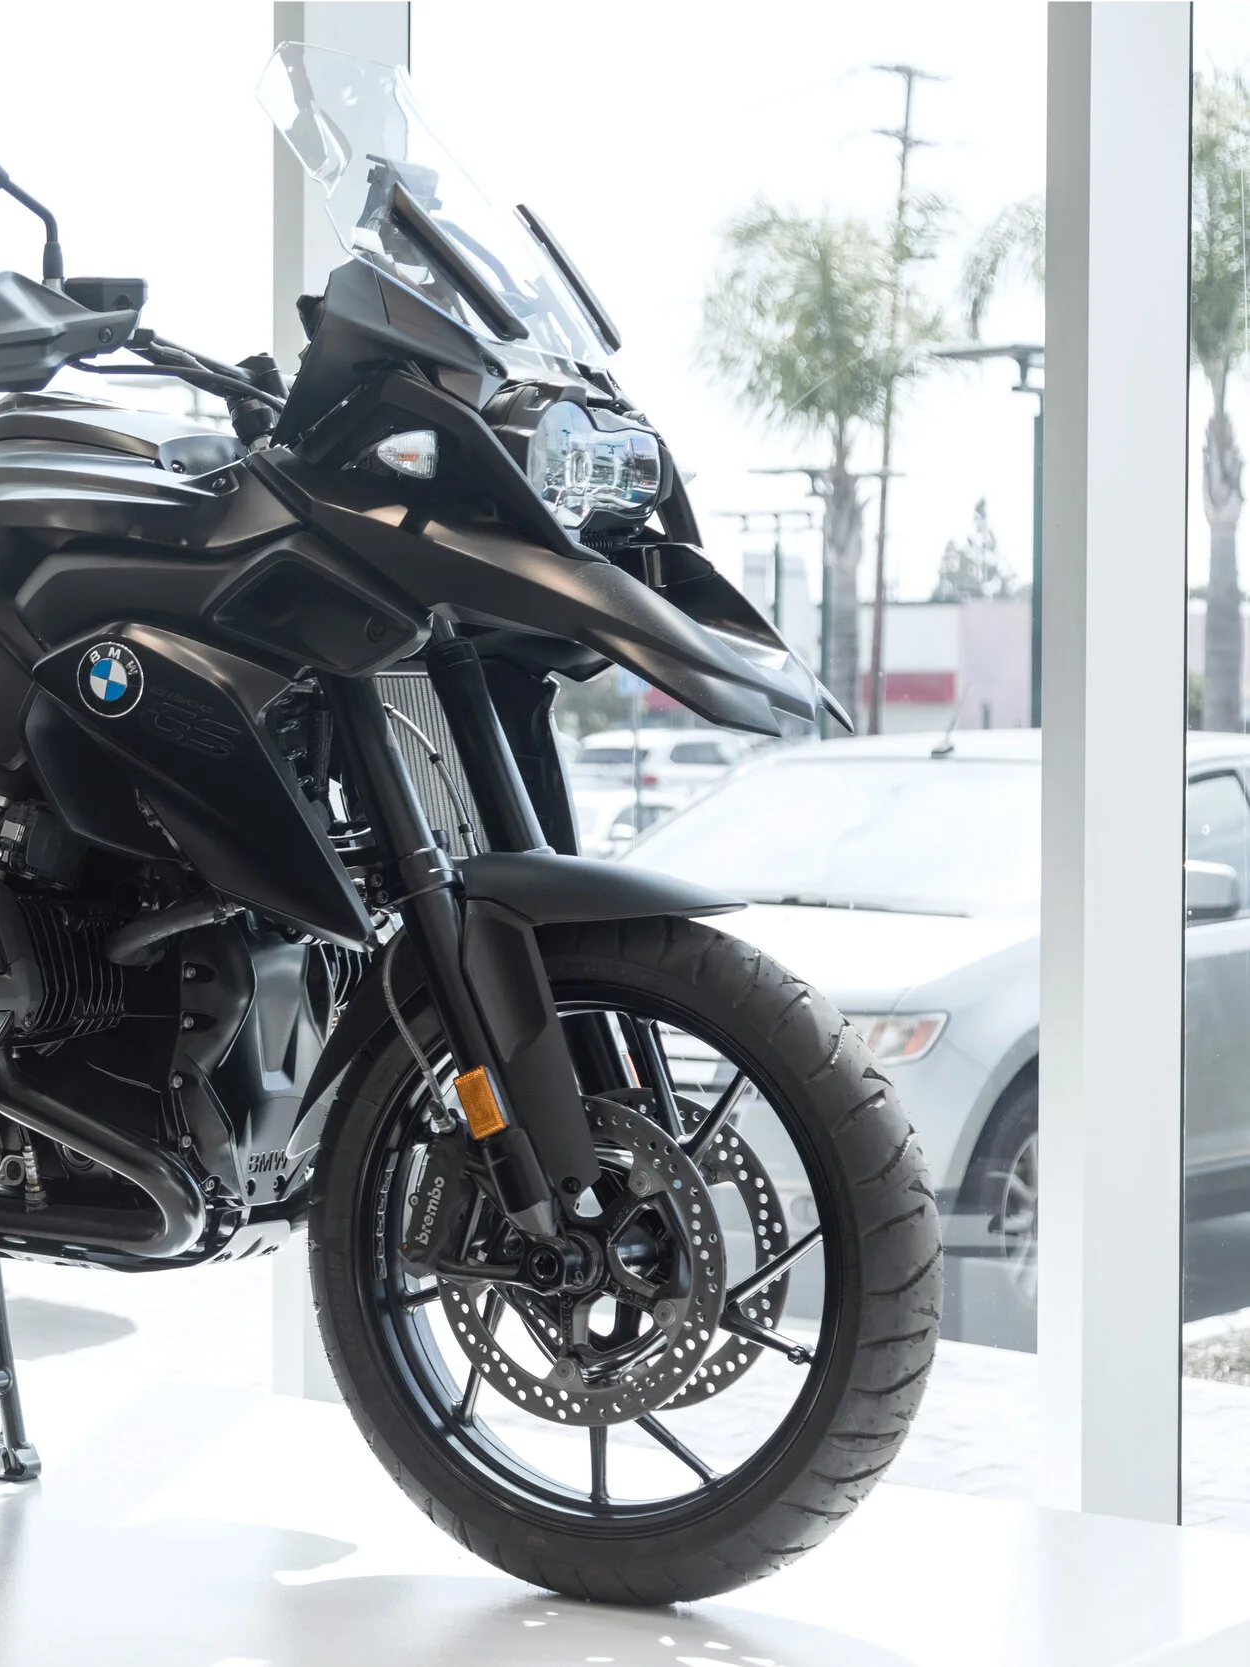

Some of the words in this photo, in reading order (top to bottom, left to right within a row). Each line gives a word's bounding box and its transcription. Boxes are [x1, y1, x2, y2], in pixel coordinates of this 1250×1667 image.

[90, 647, 138, 675] BMW
[139, 702, 243, 759] GS
[248, 1150, 287, 1173] BMW
[414, 1176, 445, 1246] brembo
